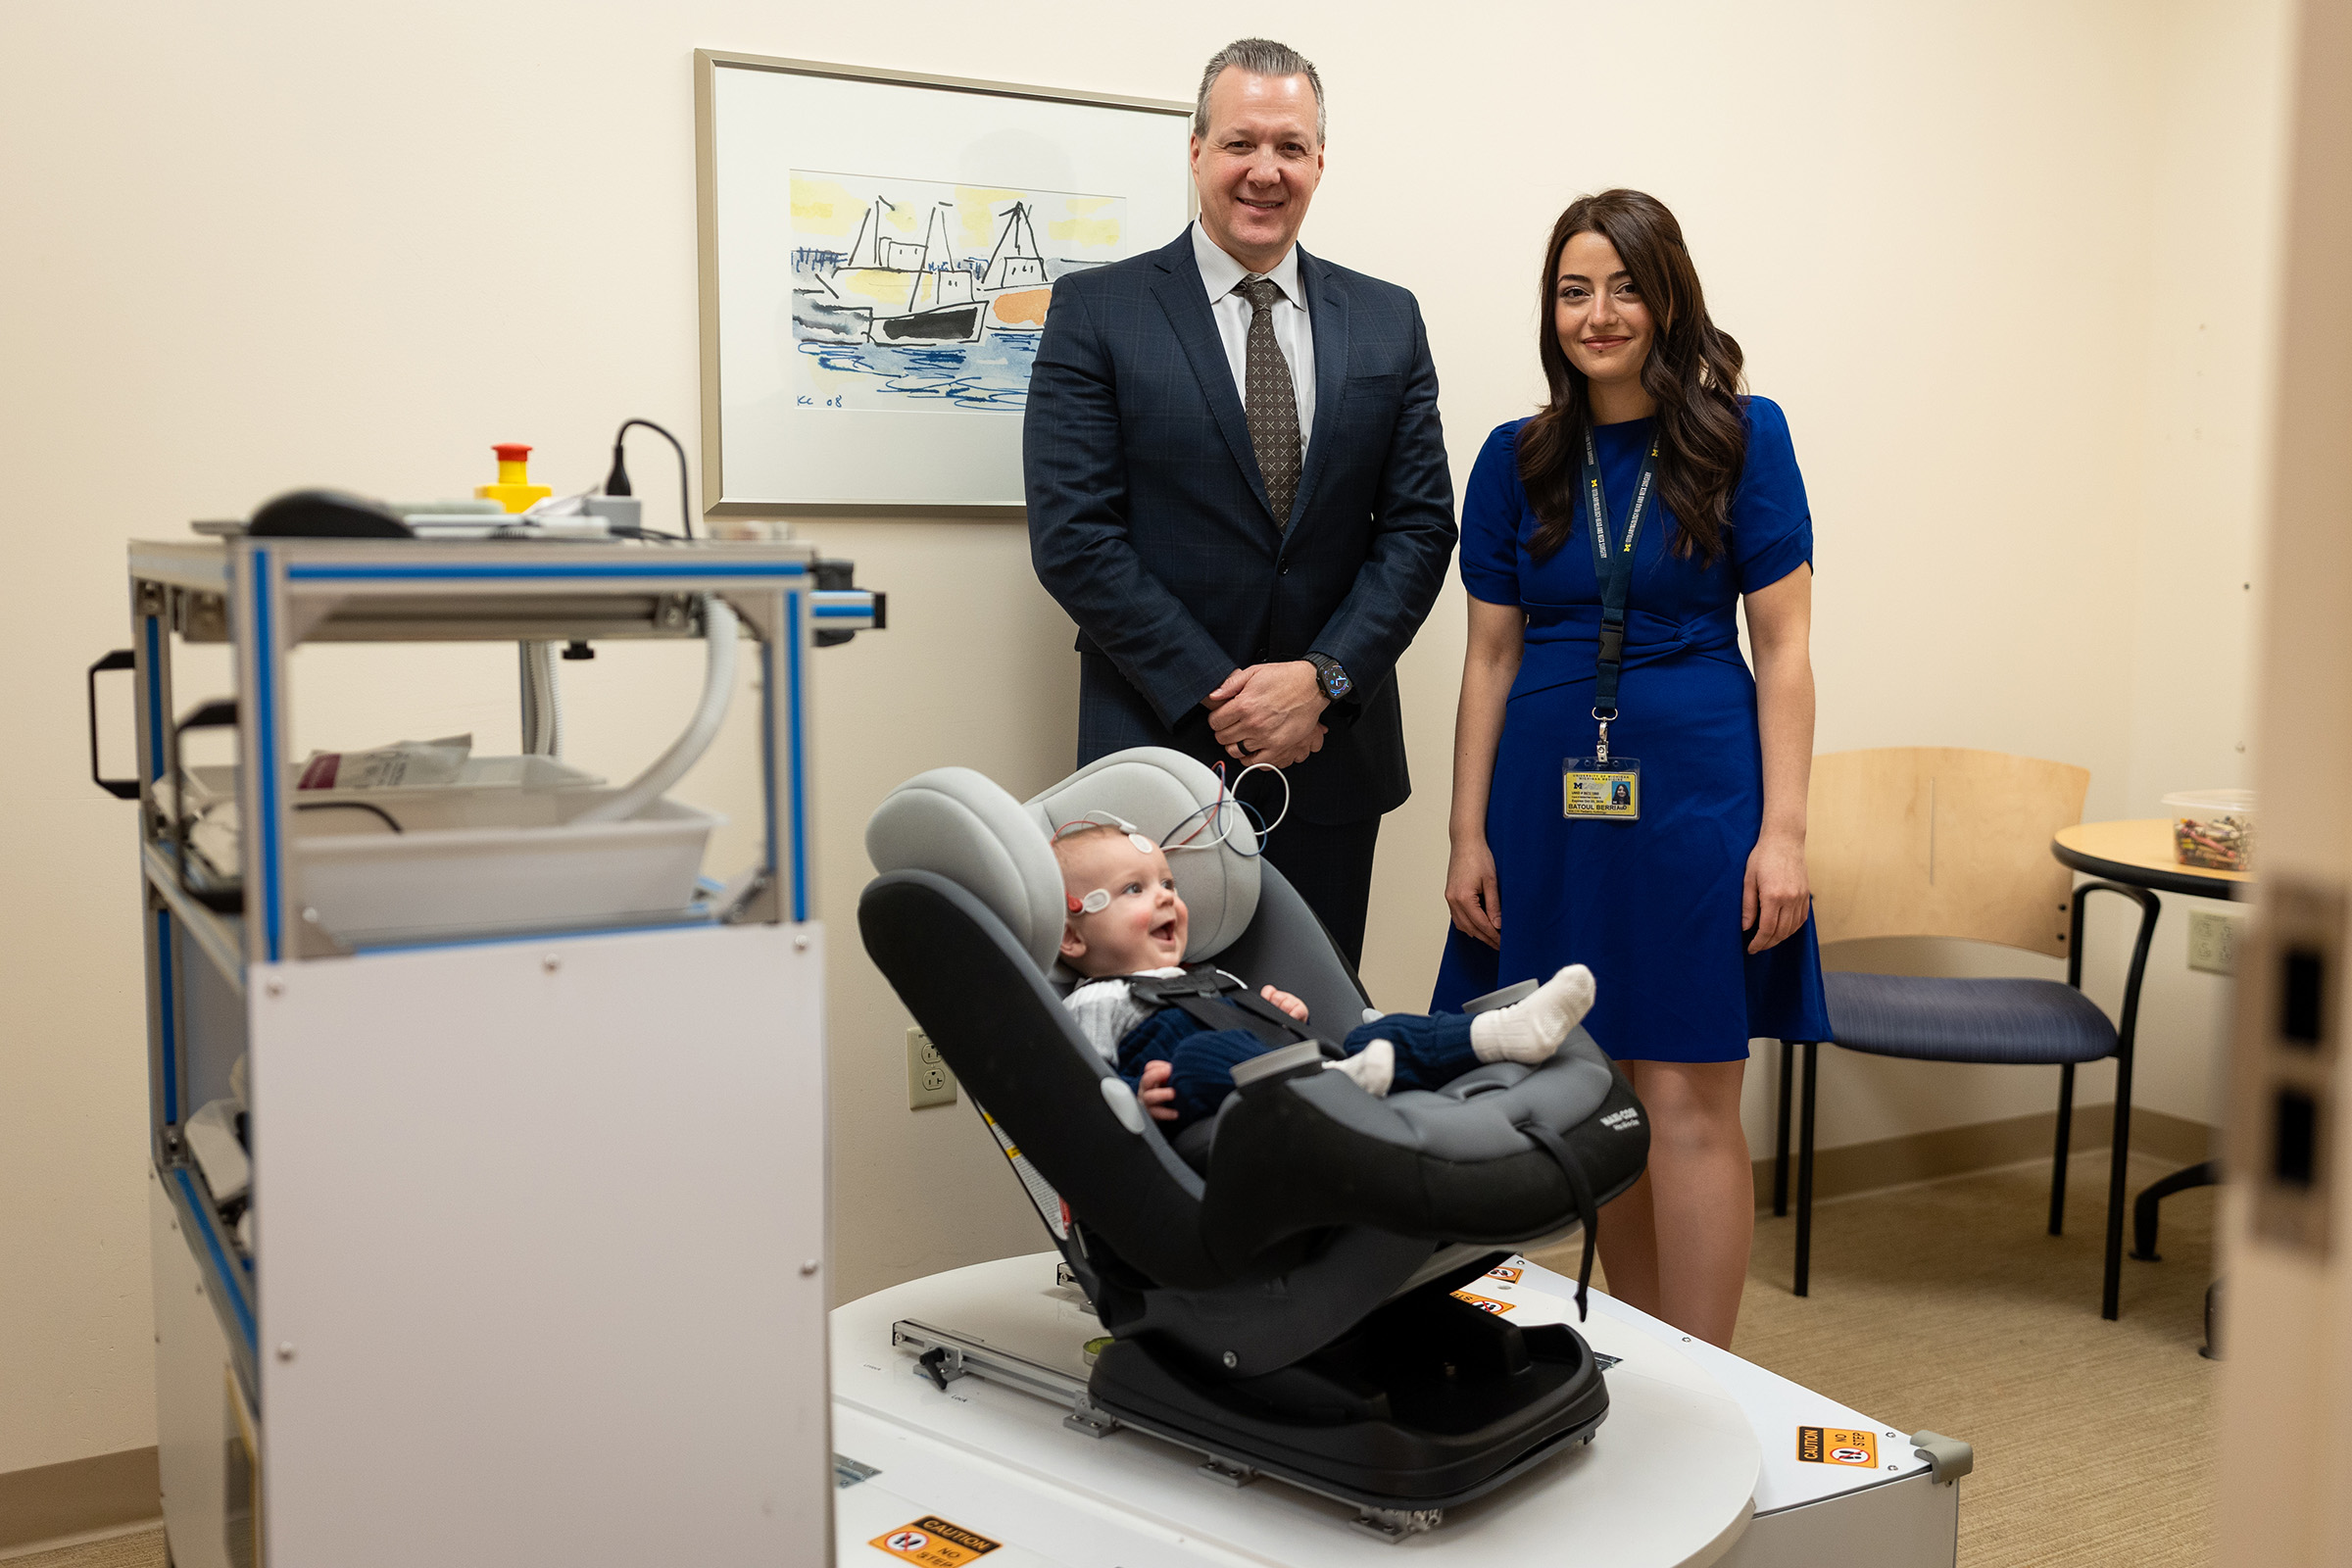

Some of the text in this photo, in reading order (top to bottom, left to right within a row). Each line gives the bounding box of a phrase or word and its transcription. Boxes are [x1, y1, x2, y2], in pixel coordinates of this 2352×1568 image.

[827, 394, 842, 408] 08
[1591, 479, 1597, 487] M
[1623, 543, 1631, 552] M
[1804, 1429, 1818, 1459] CAUTION
[1835, 1433, 1847, 1443] NO
[1853, 1432, 1865, 1446] STEP
[923, 1519, 991, 1551] CAUTION
[916, 1550, 954, 1568] STEP
[937, 1547, 961, 1558] NO
